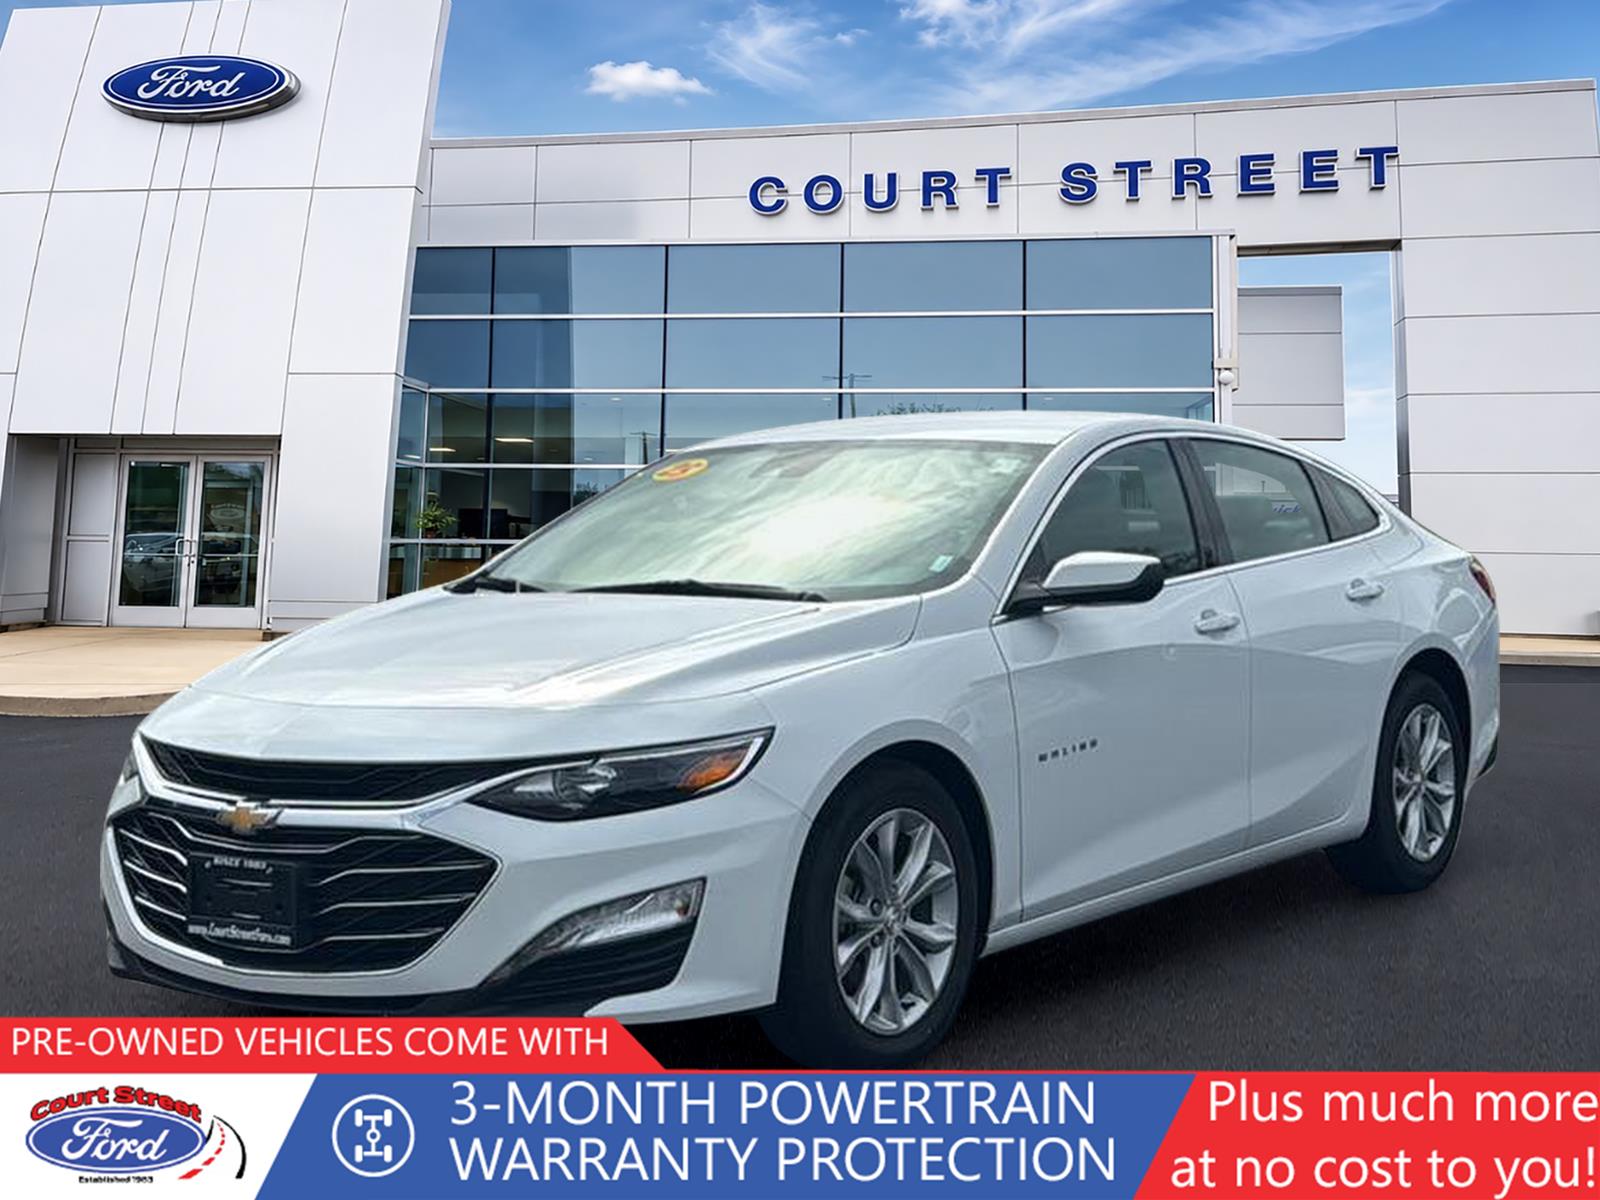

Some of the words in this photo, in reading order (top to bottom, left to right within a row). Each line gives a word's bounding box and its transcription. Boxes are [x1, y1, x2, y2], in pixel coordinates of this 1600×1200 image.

[137, 65, 246, 99] Ford
[749, 167, 1013, 214] COURT
[1059, 145, 1399, 203] STREET
